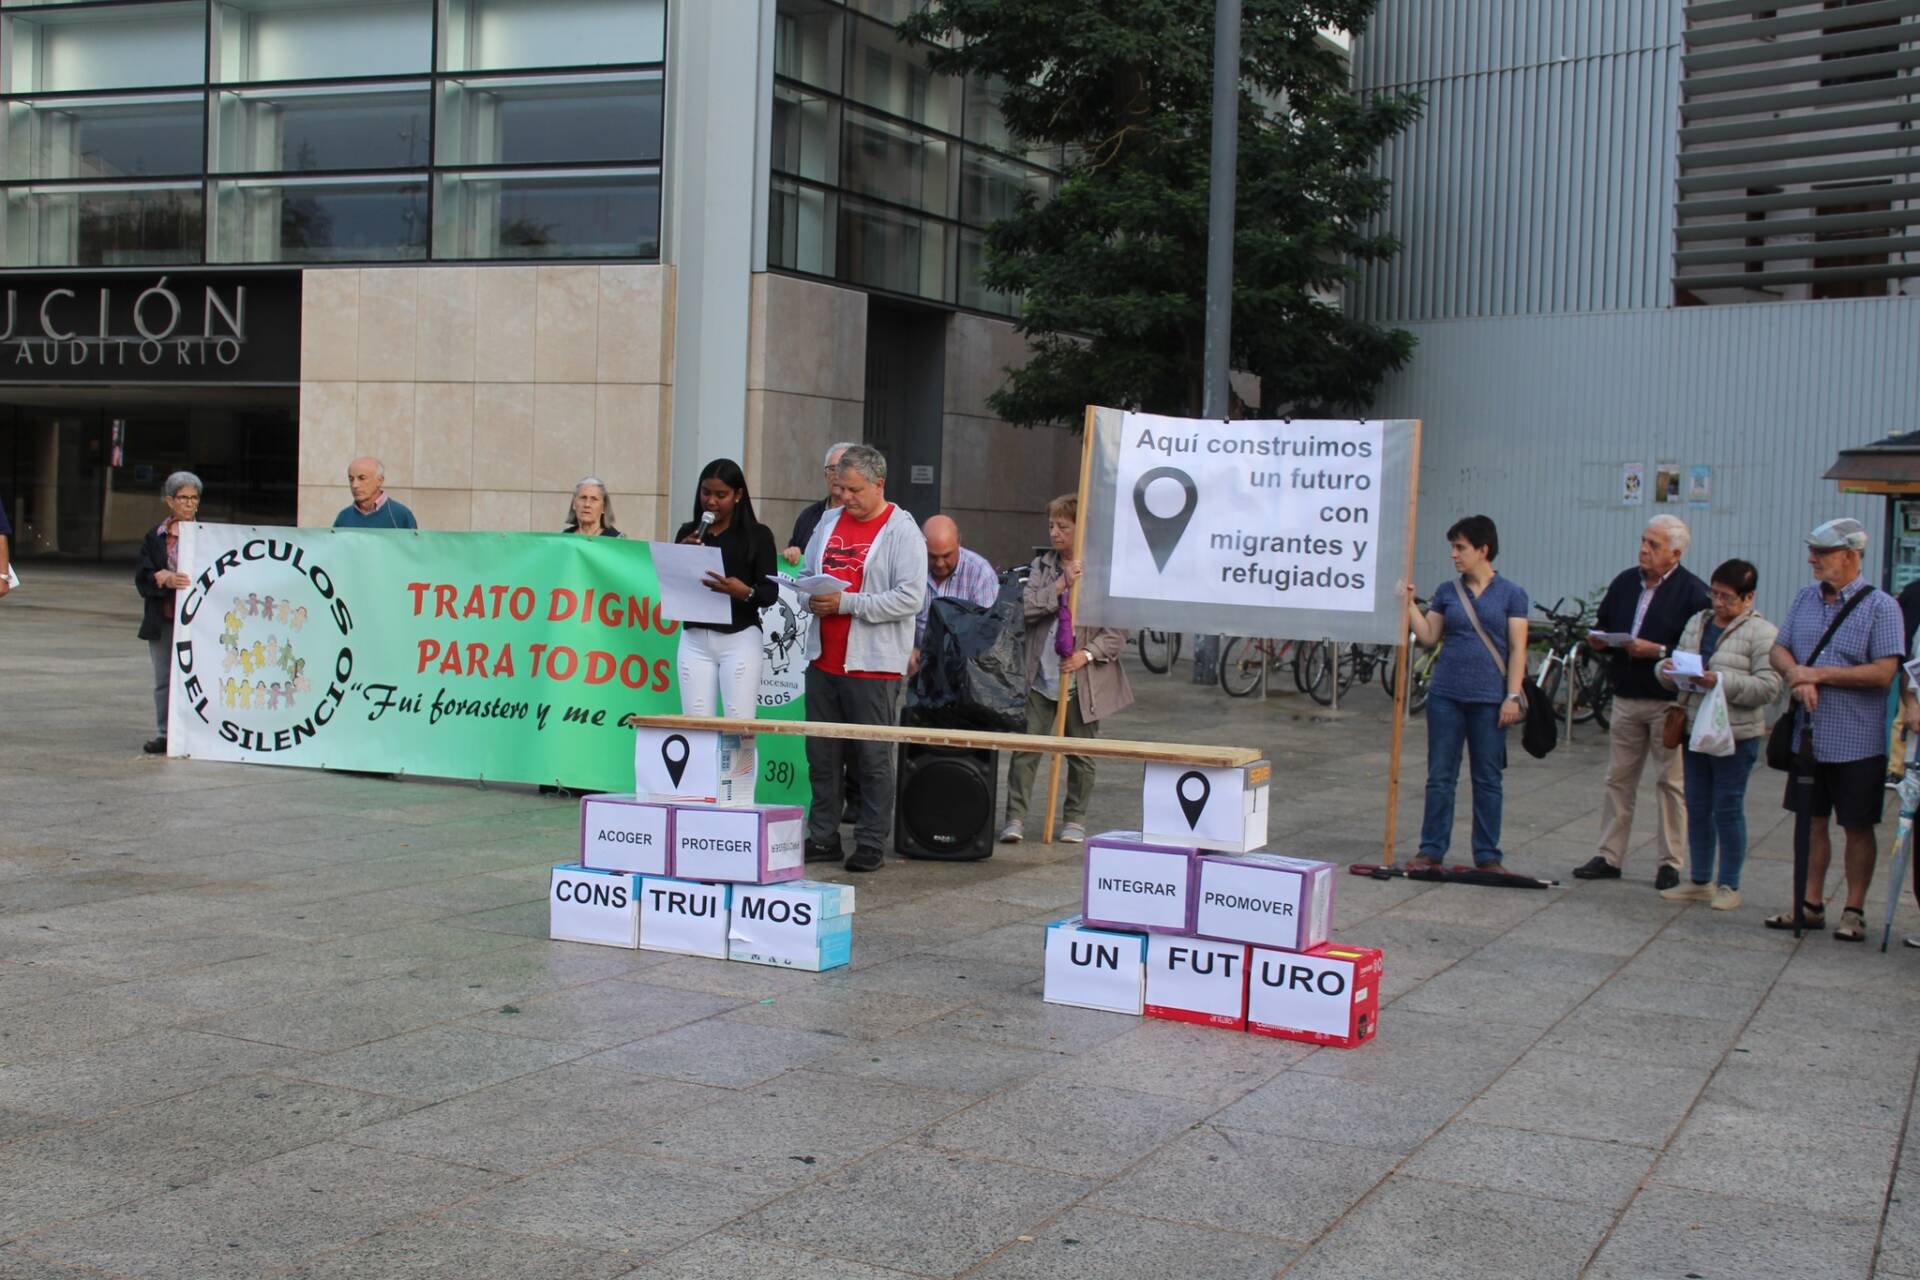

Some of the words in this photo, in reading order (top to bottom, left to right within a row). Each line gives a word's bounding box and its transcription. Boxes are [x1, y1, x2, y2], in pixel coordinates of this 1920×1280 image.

[16, 339, 240, 365] AUDITORIO
[1136, 428, 1199, 457] Aquí
[1206, 435, 1372, 458] construimos
[1250, 470, 1281, 488] un
[1291, 467, 1371, 491] futuro
[1319, 505, 1369, 524] con
[1210, 530, 1343, 557] migrantes
[1353, 539, 1368, 562] y
[180, 538, 354, 636] CIRCULOS
[1221, 562, 1366, 592] refugiados
[407, 582, 536, 621] TRATO
[416, 639, 515, 678] PARA
[527, 643, 671, 693] TODOS
[176, 640, 210, 724] DEL
[218, 647, 354, 752] SILENCIO
[430, 687, 528, 725] forastero
[537, 698, 553, 731] y
[563, 705, 606, 727] me
[598, 829, 652, 846] ACOGER
[681, 837, 752, 853] PROTEGER
[556, 879, 628, 909] CONS
[649, 888, 717, 918] TRUI
[741, 896, 812, 926] MOS
[1098, 877, 1176, 897] INTEGRAR
[1204, 892, 1294, 917] PROMOVER
[1070, 941, 1119, 971] UN
[1168, 946, 1239, 978] FUT
[1262, 961, 1345, 997] URO
